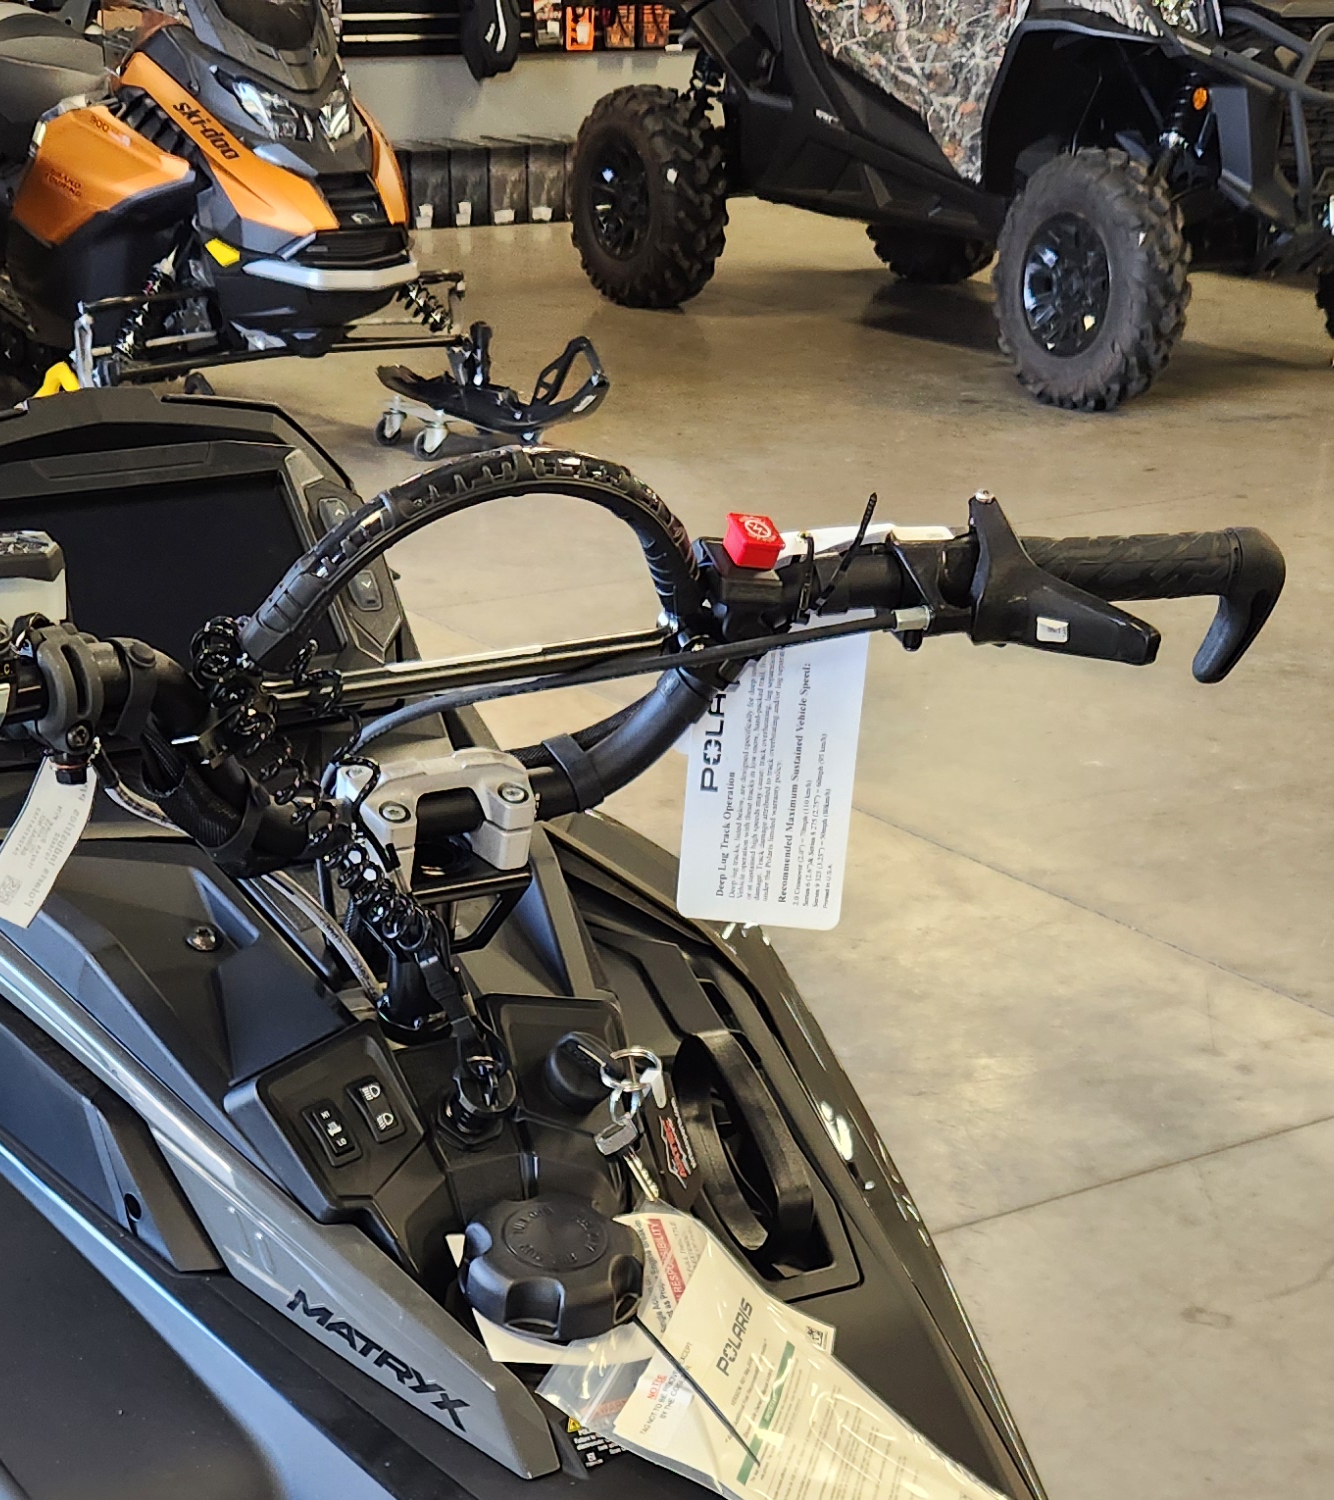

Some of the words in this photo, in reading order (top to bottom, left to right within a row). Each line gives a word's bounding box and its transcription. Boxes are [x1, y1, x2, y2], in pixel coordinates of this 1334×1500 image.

[173, 102, 239, 160] ski-doo
[799, 662, 812, 695] Speed:
[795, 697, 807, 732] Vehicle
[700, 692, 726, 793] POLA
[790, 735, 804, 781] Sustained
[723, 771, 737, 819] Operation
[785, 783, 798, 831] Maximum
[720, 822, 730, 849] Track
[716, 873, 726, 896] Deep
[718, 852, 728, 870] Lug
[778, 834, 792, 902] Recommended
[286, 1289, 471, 1432] MATRYX
[716, 1298, 753, 1377] POLARIS
